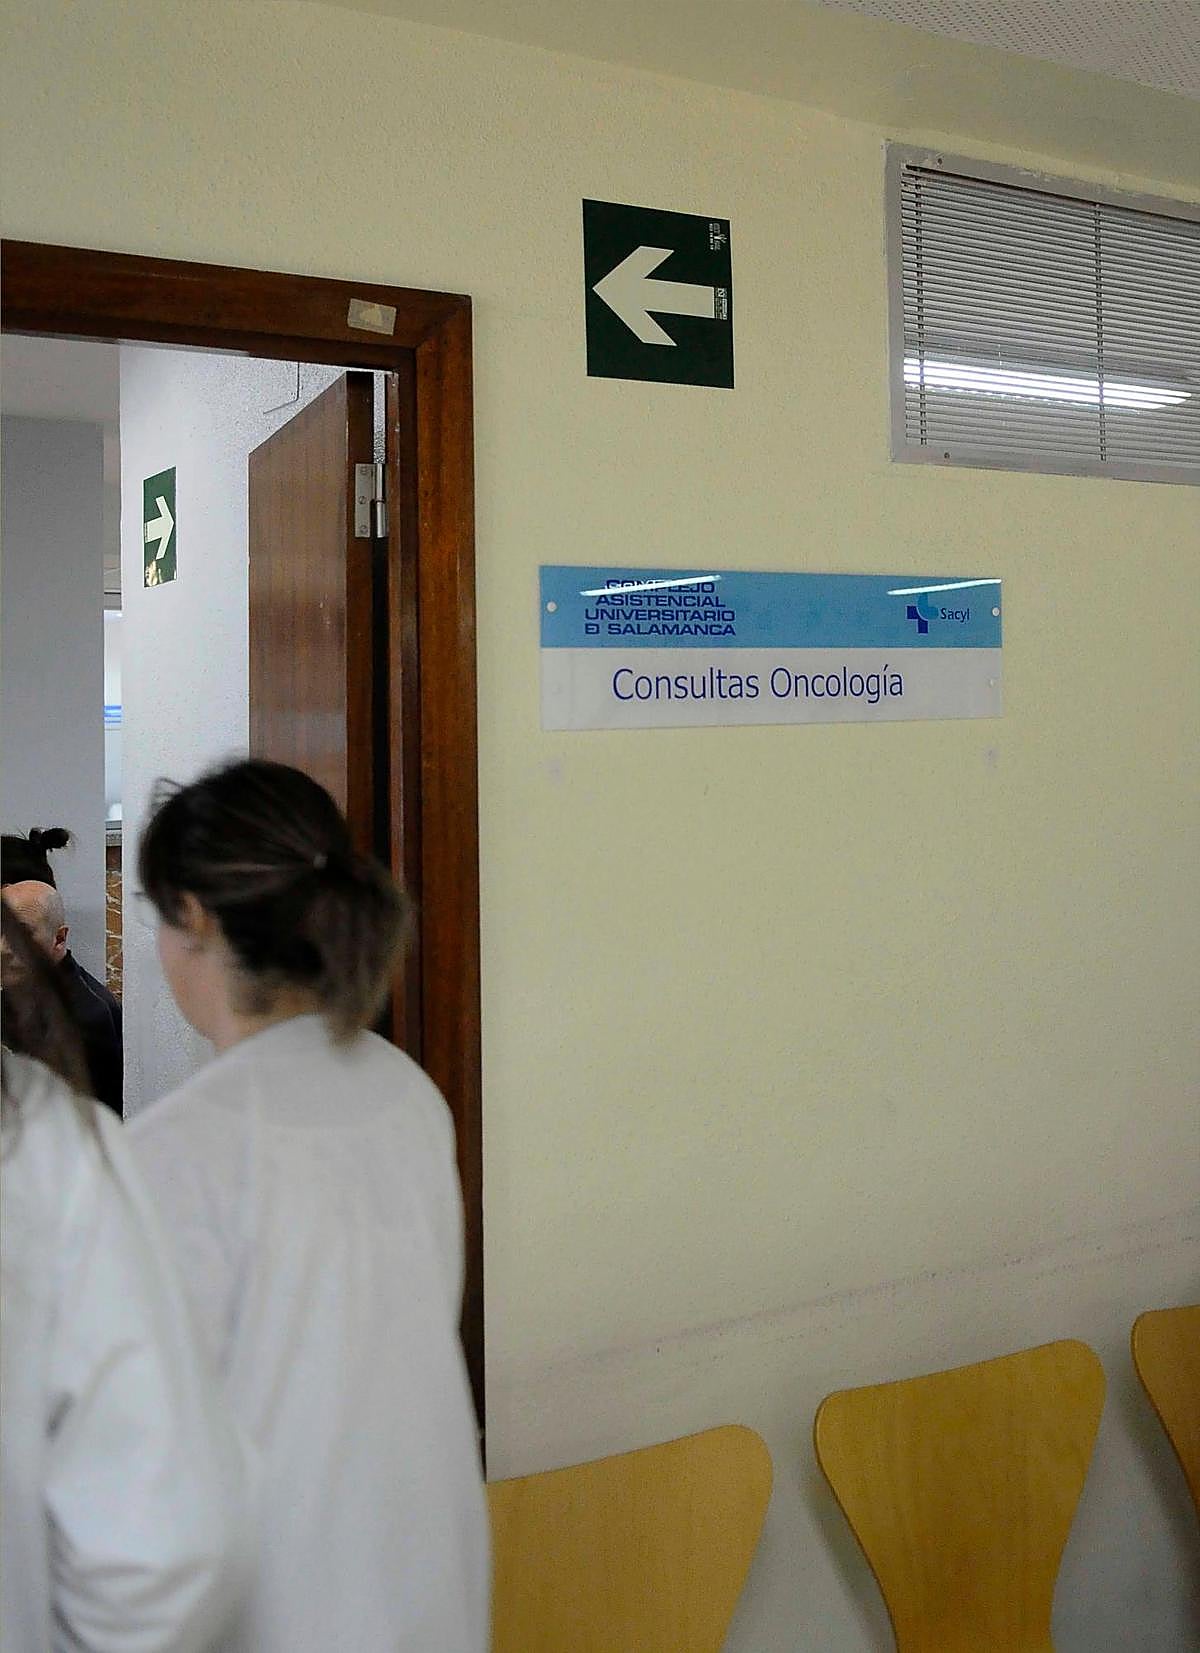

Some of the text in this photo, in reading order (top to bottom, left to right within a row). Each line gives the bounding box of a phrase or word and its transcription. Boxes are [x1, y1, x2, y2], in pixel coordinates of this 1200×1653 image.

[596, 595, 726, 607] ASISTENCIAL
[585, 609, 735, 621] UNIVERSITARIO
[940, 607, 970, 624] Sacyl
[608, 623, 736, 636] SALAMANCA
[612, 664, 904, 704] Consultas Oncología
